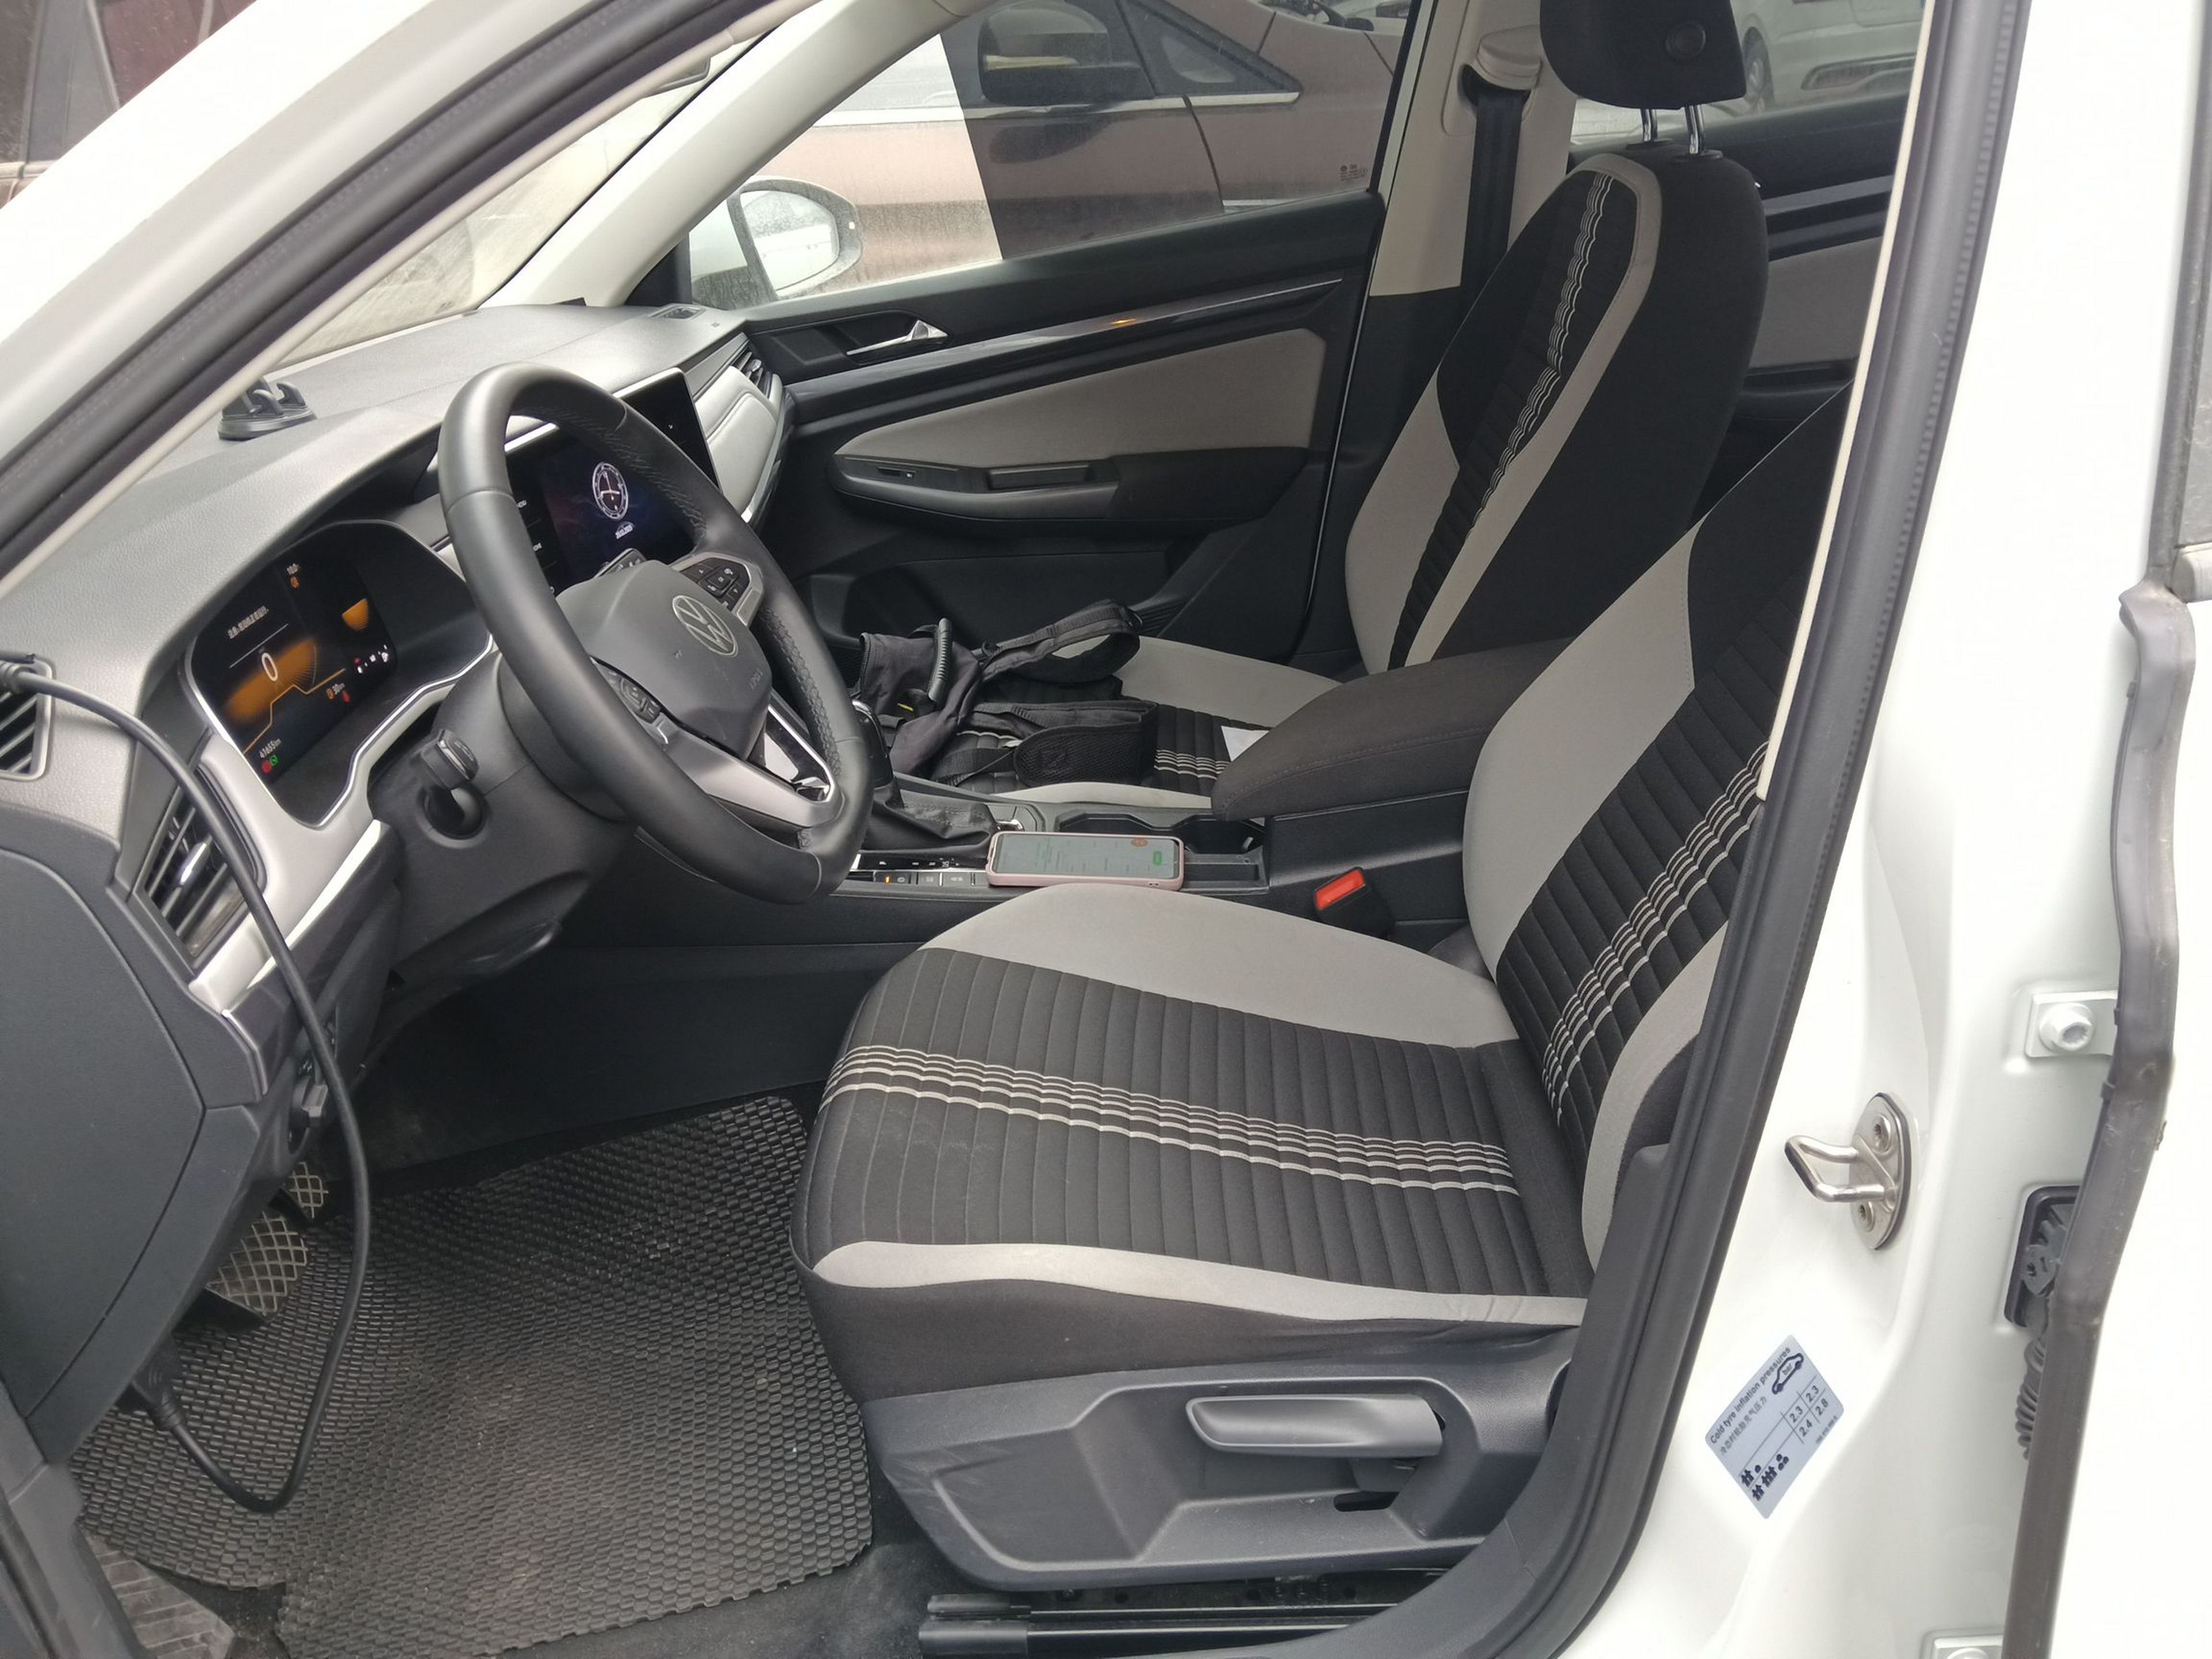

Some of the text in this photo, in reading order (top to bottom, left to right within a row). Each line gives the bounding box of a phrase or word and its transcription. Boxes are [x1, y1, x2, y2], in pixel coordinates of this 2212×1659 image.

[261, 652, 278, 681] 0
[1782, 1363, 1793, 1376] bar
[1710, 1347, 1791, 1444] Cold tyre inflation pressures
[1789, 1385, 1820, 1423] 2.3 2.3
[1798, 1419, 1813, 1437] 2.4
[1815, 1398, 1830, 1415] 2.8
